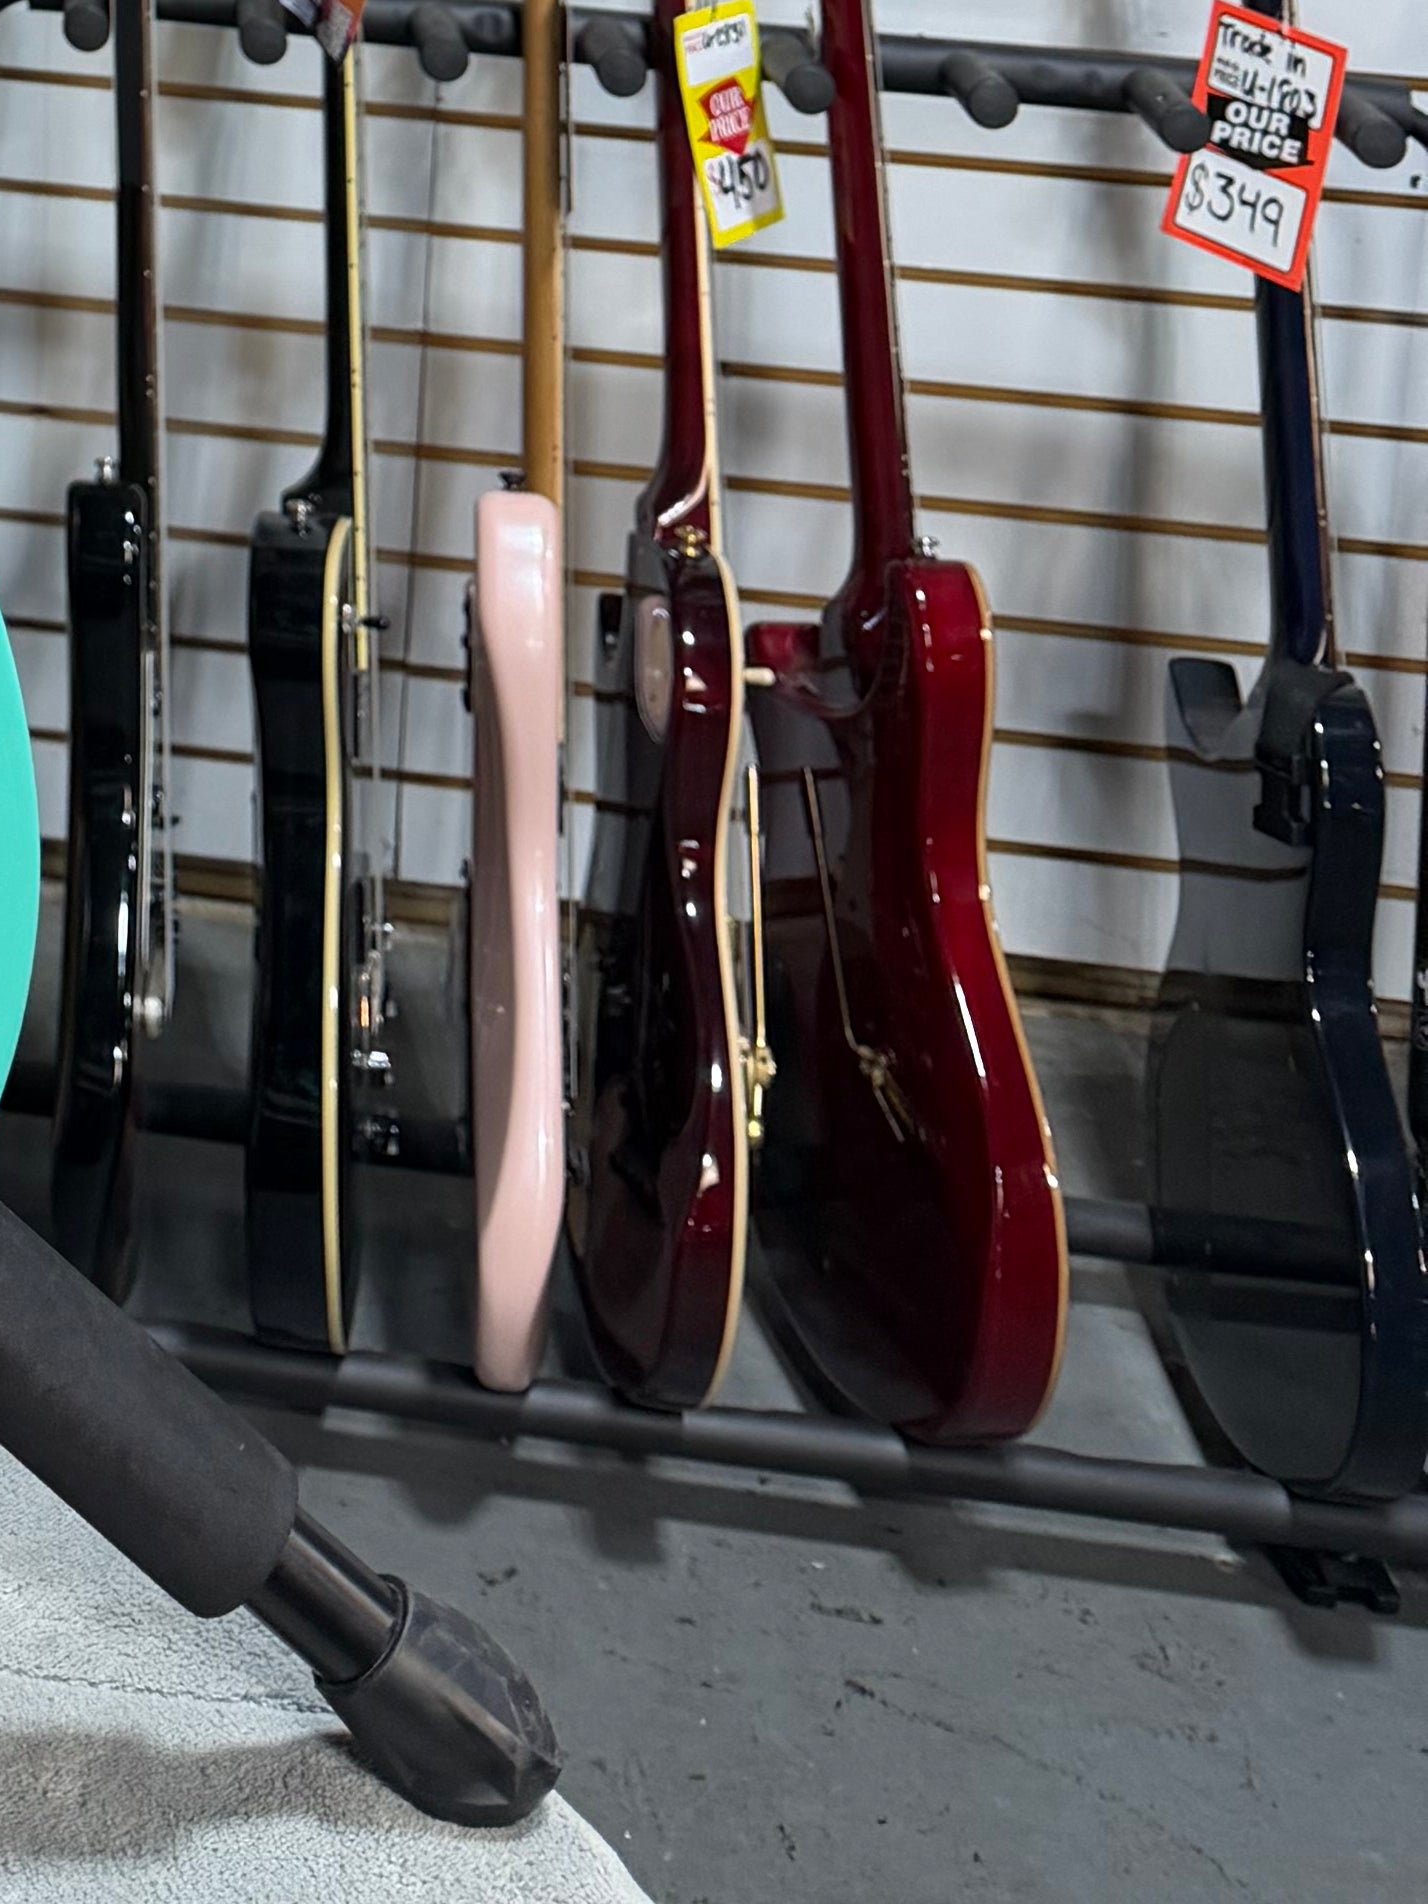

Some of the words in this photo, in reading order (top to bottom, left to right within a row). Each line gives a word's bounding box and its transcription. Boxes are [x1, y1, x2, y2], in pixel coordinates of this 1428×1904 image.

[708, 85, 745, 120] OUR
[1224, 99, 1291, 137] OUR
[707, 106, 751, 143] PRICE
[1210, 119, 1303, 164] PRICE
[1184, 161, 1285, 248] $349
